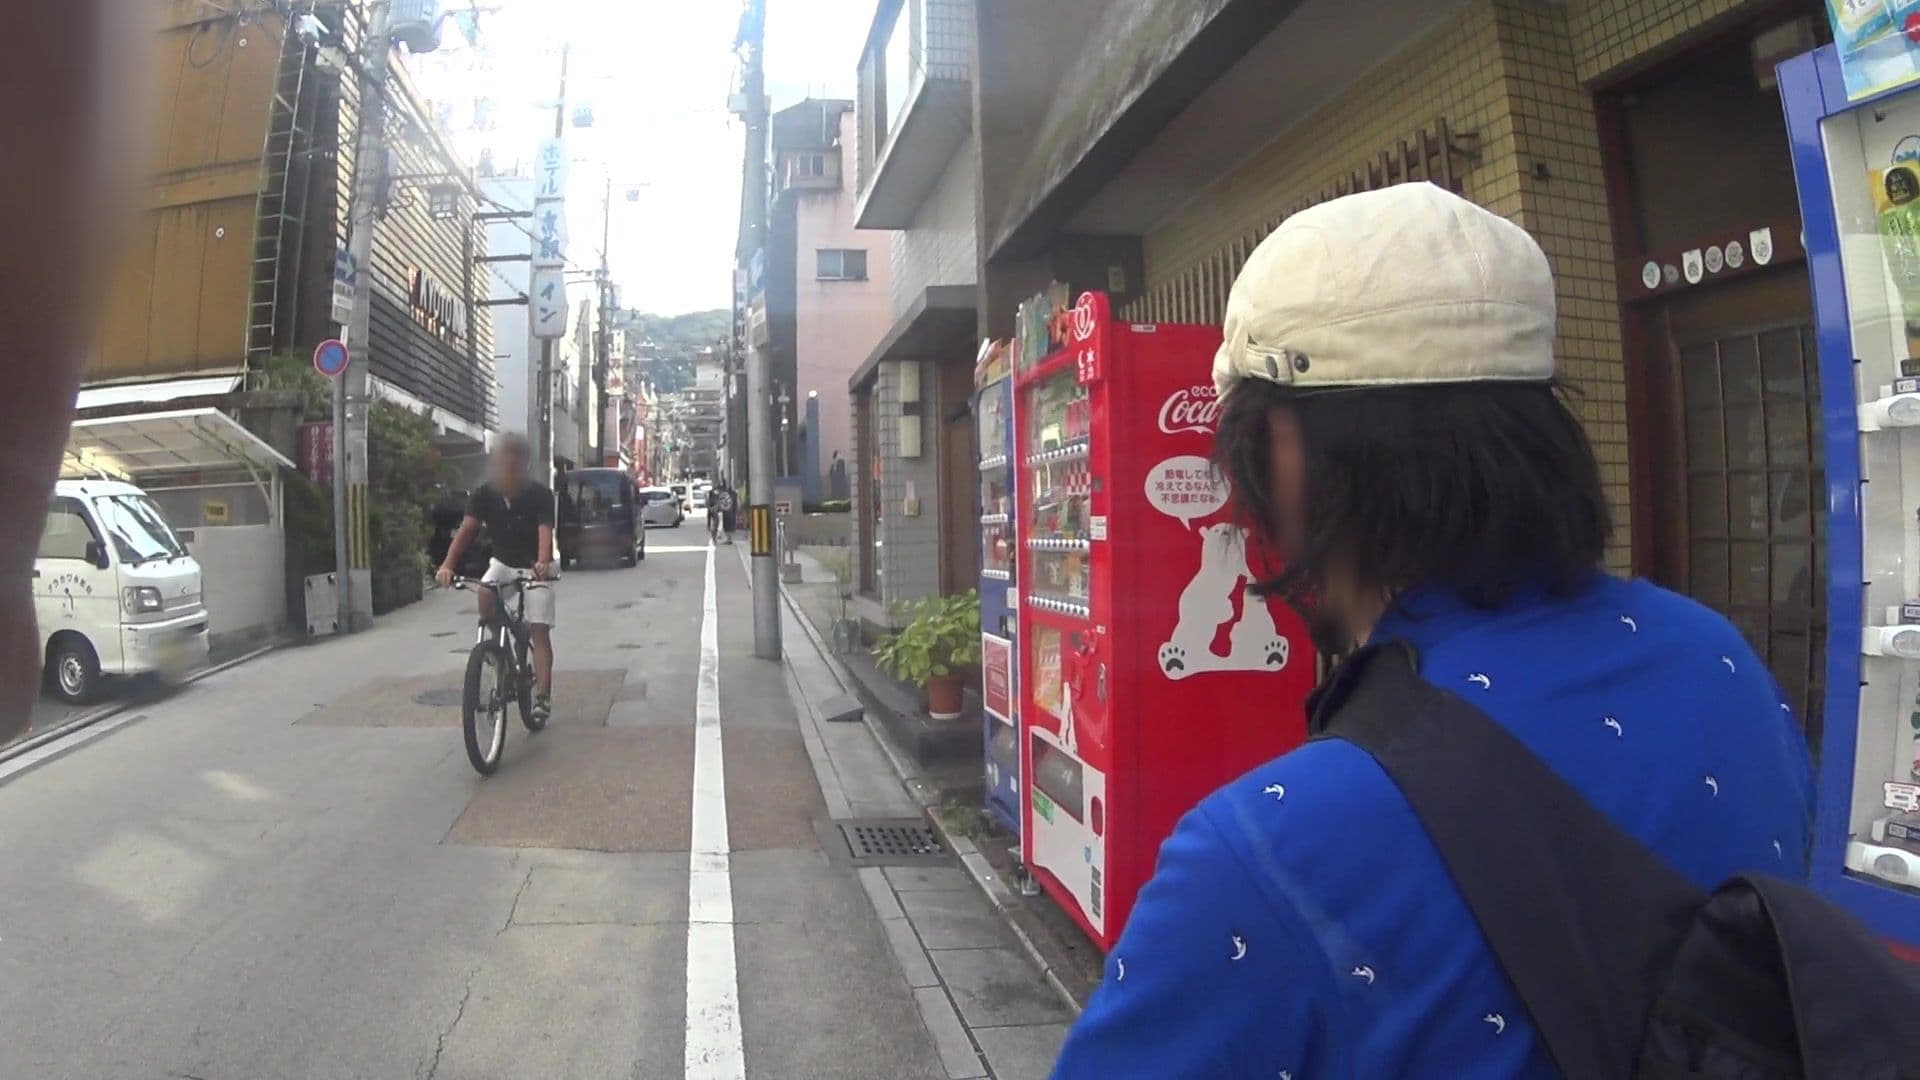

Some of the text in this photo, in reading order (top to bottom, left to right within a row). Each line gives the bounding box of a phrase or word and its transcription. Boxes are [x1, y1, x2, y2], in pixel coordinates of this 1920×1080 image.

[419, 270, 453, 328] KYOTO
[540, 281, 557, 323] イン
[1191, 386, 1217, 397] eco
